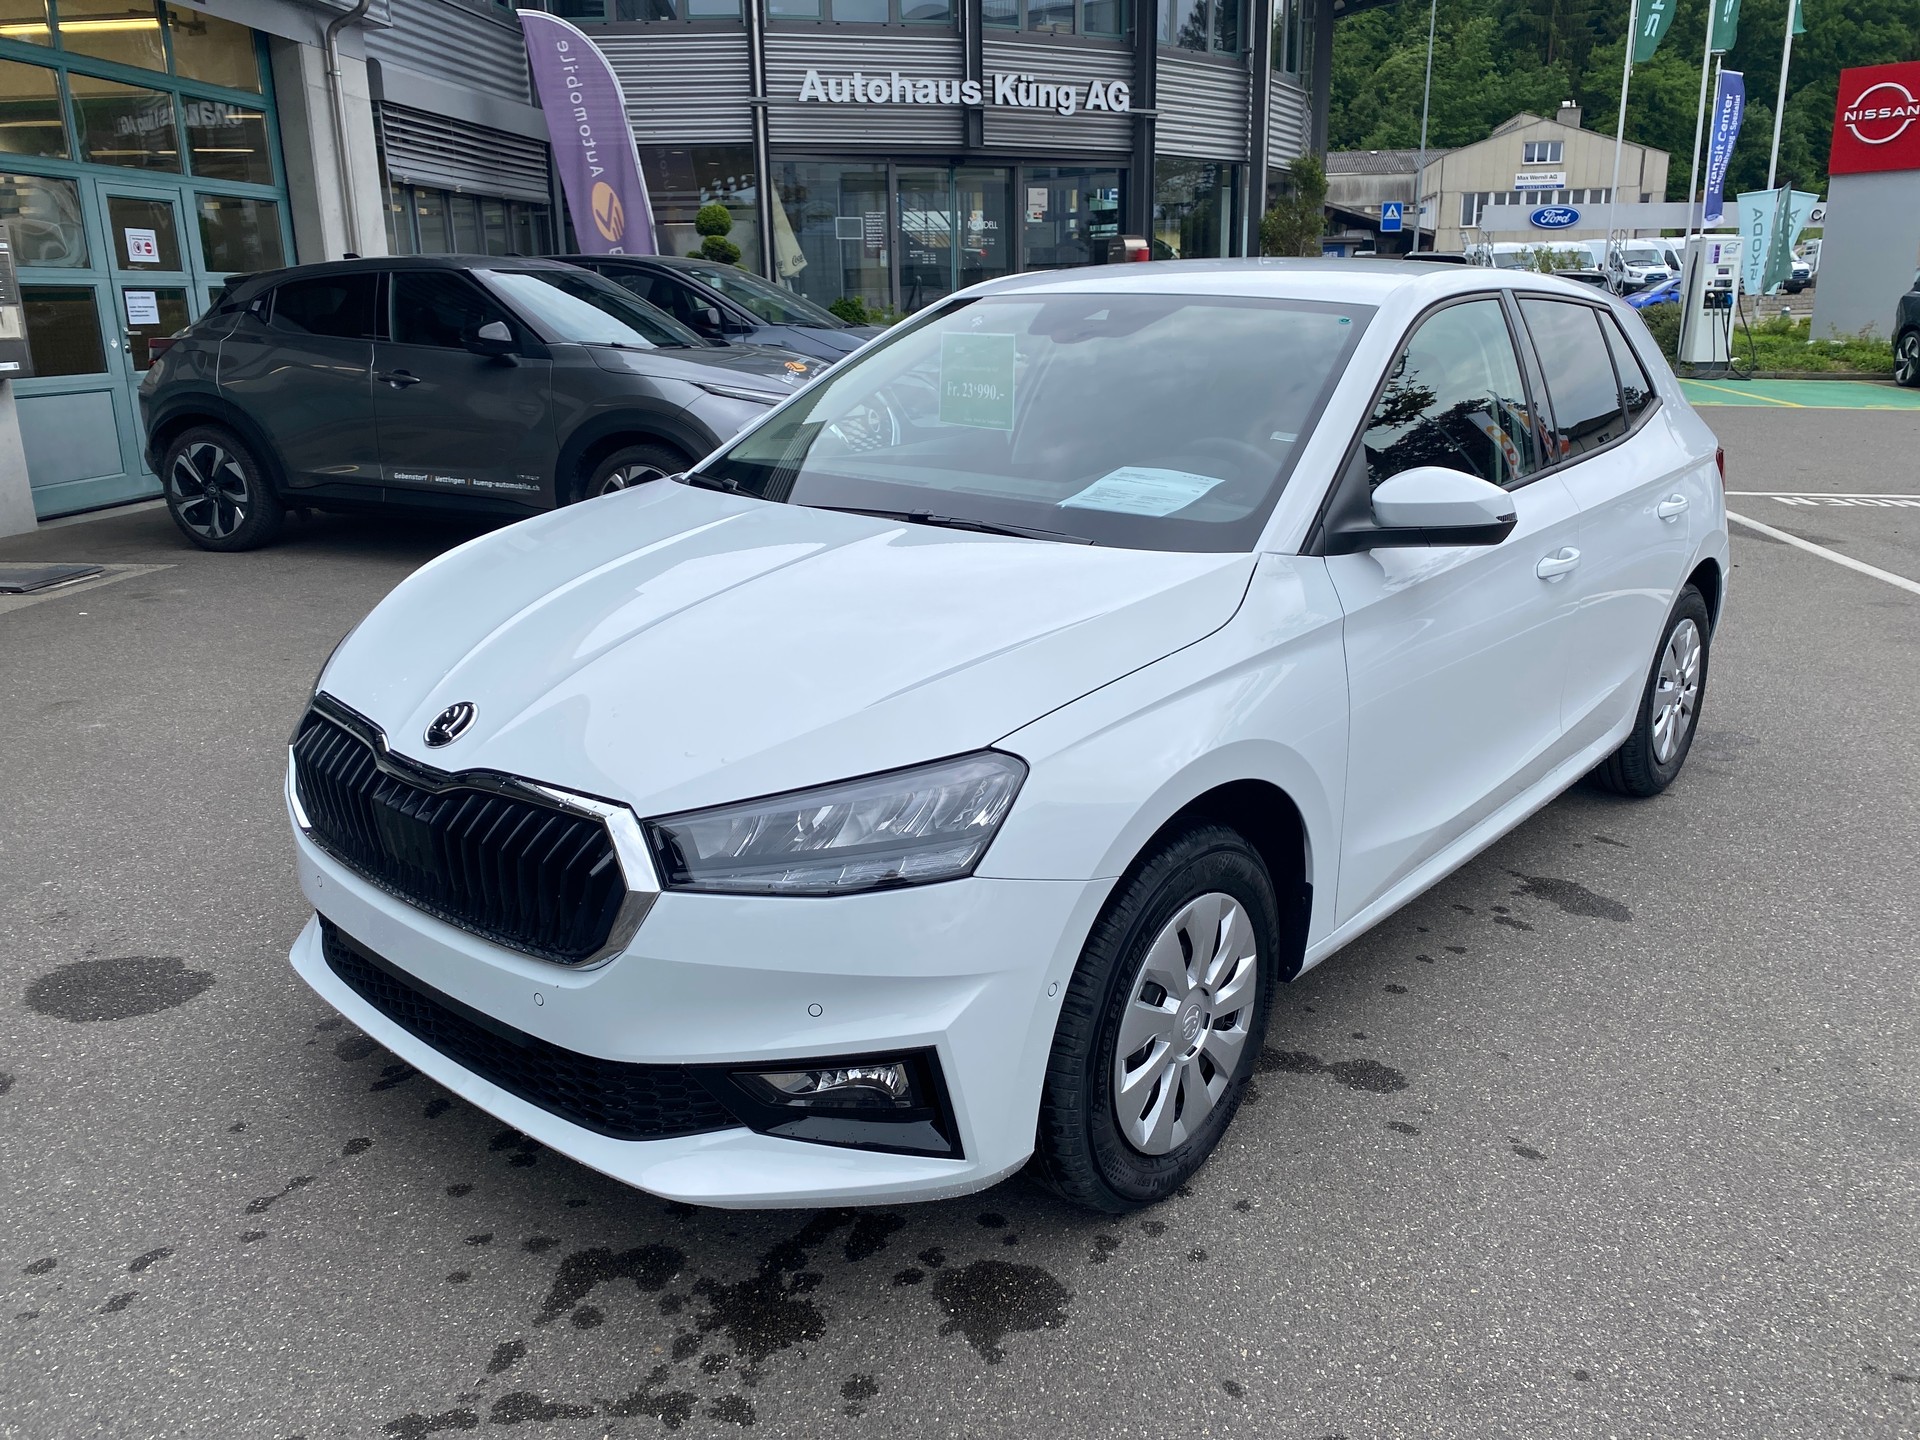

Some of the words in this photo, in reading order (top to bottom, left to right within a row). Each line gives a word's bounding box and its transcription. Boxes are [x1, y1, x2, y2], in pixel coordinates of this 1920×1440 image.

[798, 70, 982, 105] Autohaus
[994, 74, 1077, 115] Küng
[1086, 80, 1130, 112] AG
[1718, 94, 1733, 141] Center
[1730, 95, 1741, 130] Spezialist
[1844, 105, 1920, 121] NISSAN
[1540, 209, 1571, 223] Ford
[947, 381, 960, 397] Fr.
[394, 472, 428, 481] Gebenstorf
[435, 475, 465, 485] Wettingen
[473, 479, 540, 491] kueng-automobile.ch
